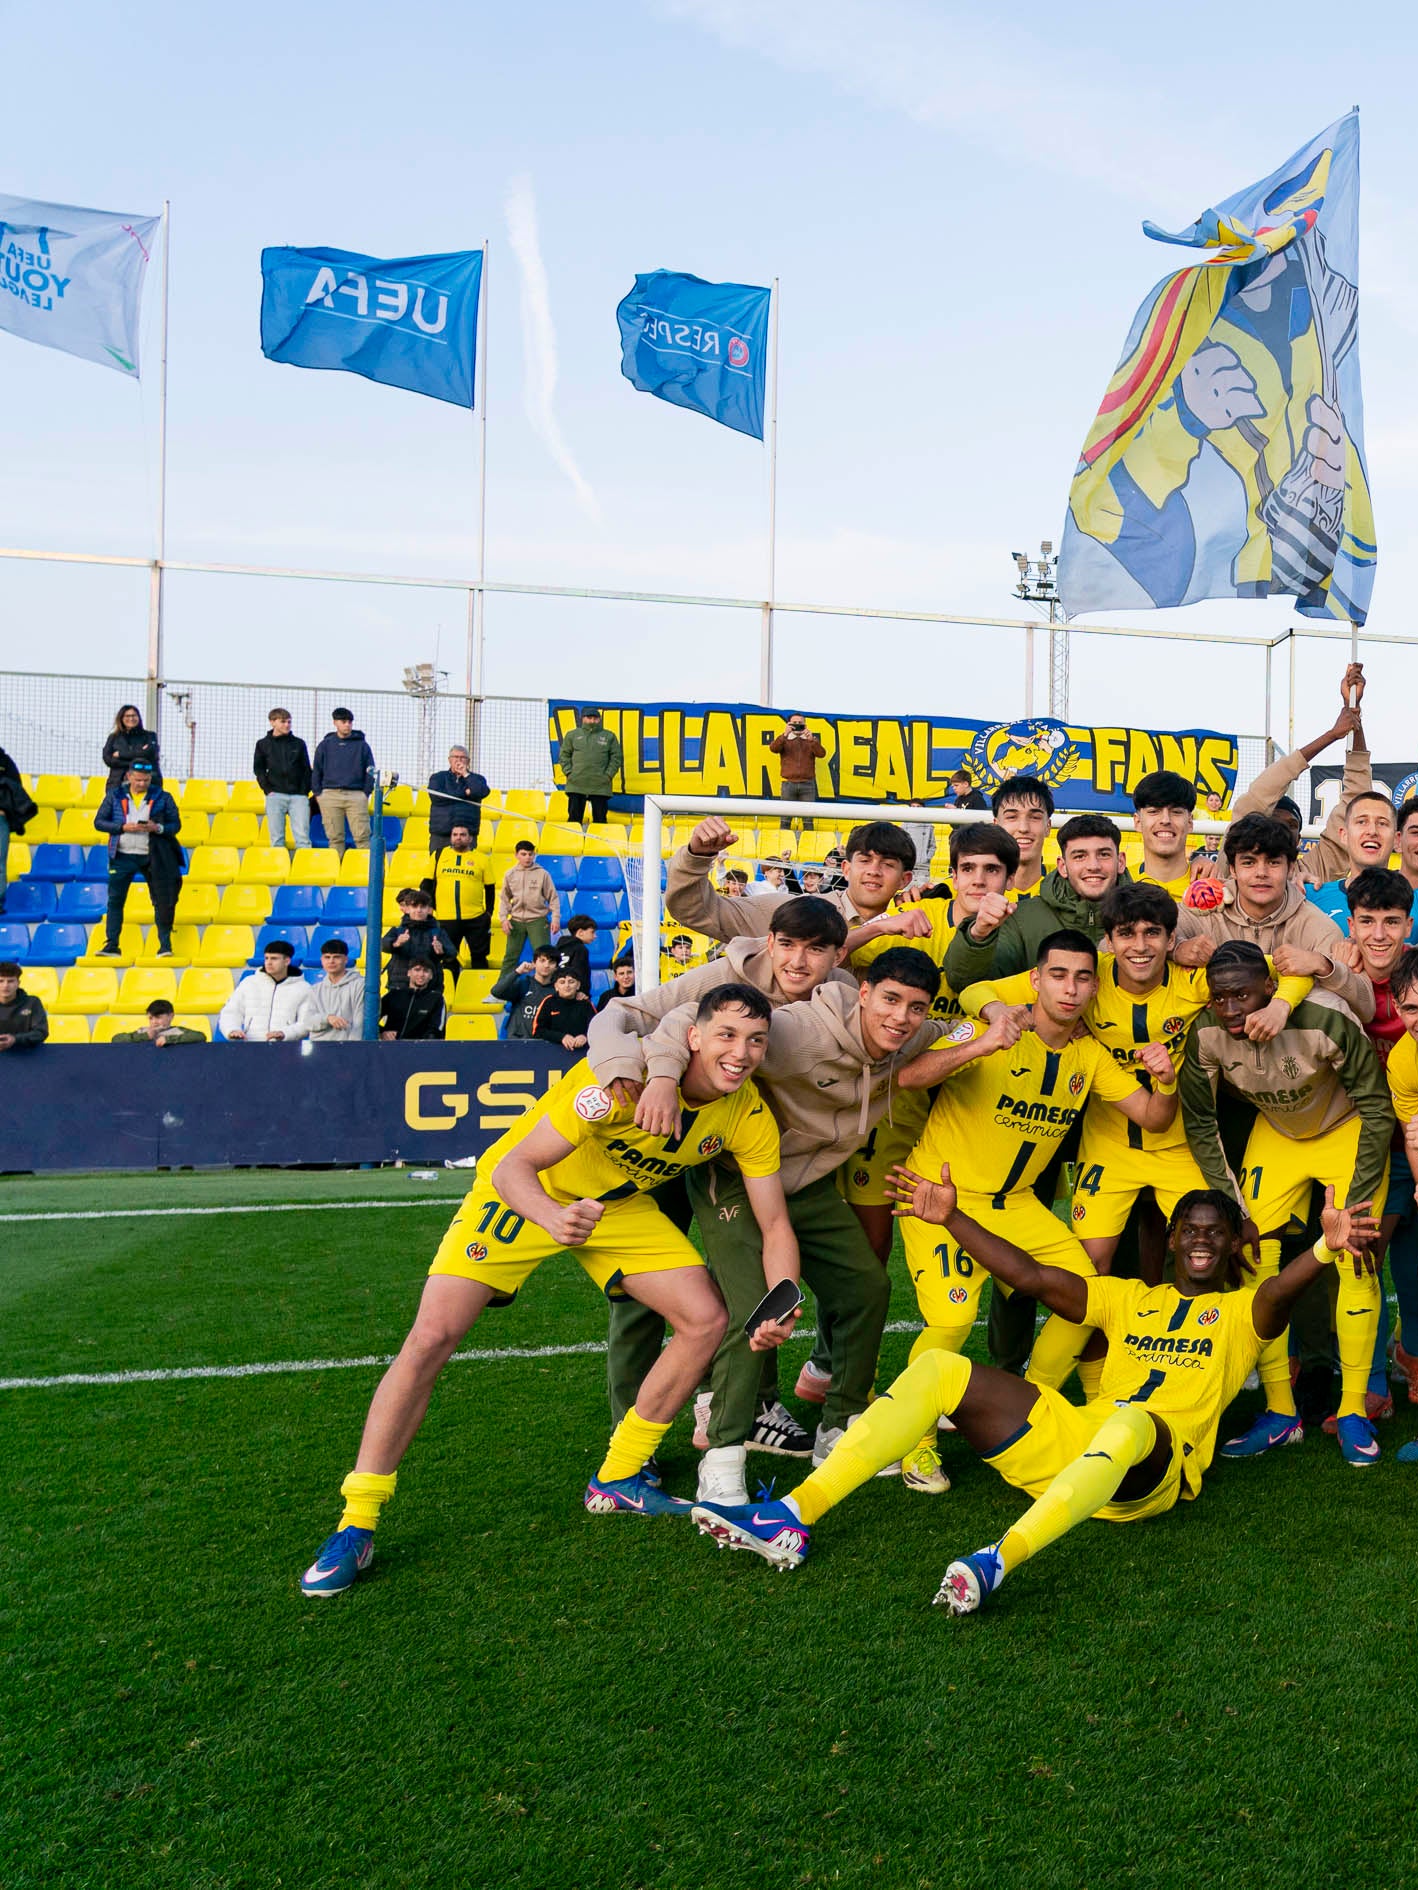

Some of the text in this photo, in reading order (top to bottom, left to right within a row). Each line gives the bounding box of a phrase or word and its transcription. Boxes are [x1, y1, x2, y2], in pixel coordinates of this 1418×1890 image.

[1090, 727, 1234, 807] FANS
[1394, 773, 1418, 805] VILLARR
[404, 1070, 562, 1131] GS
[996, 1093, 1080, 1126] PAMESA
[474, 1201, 526, 1245] 10
[933, 1243, 974, 1278] 16
